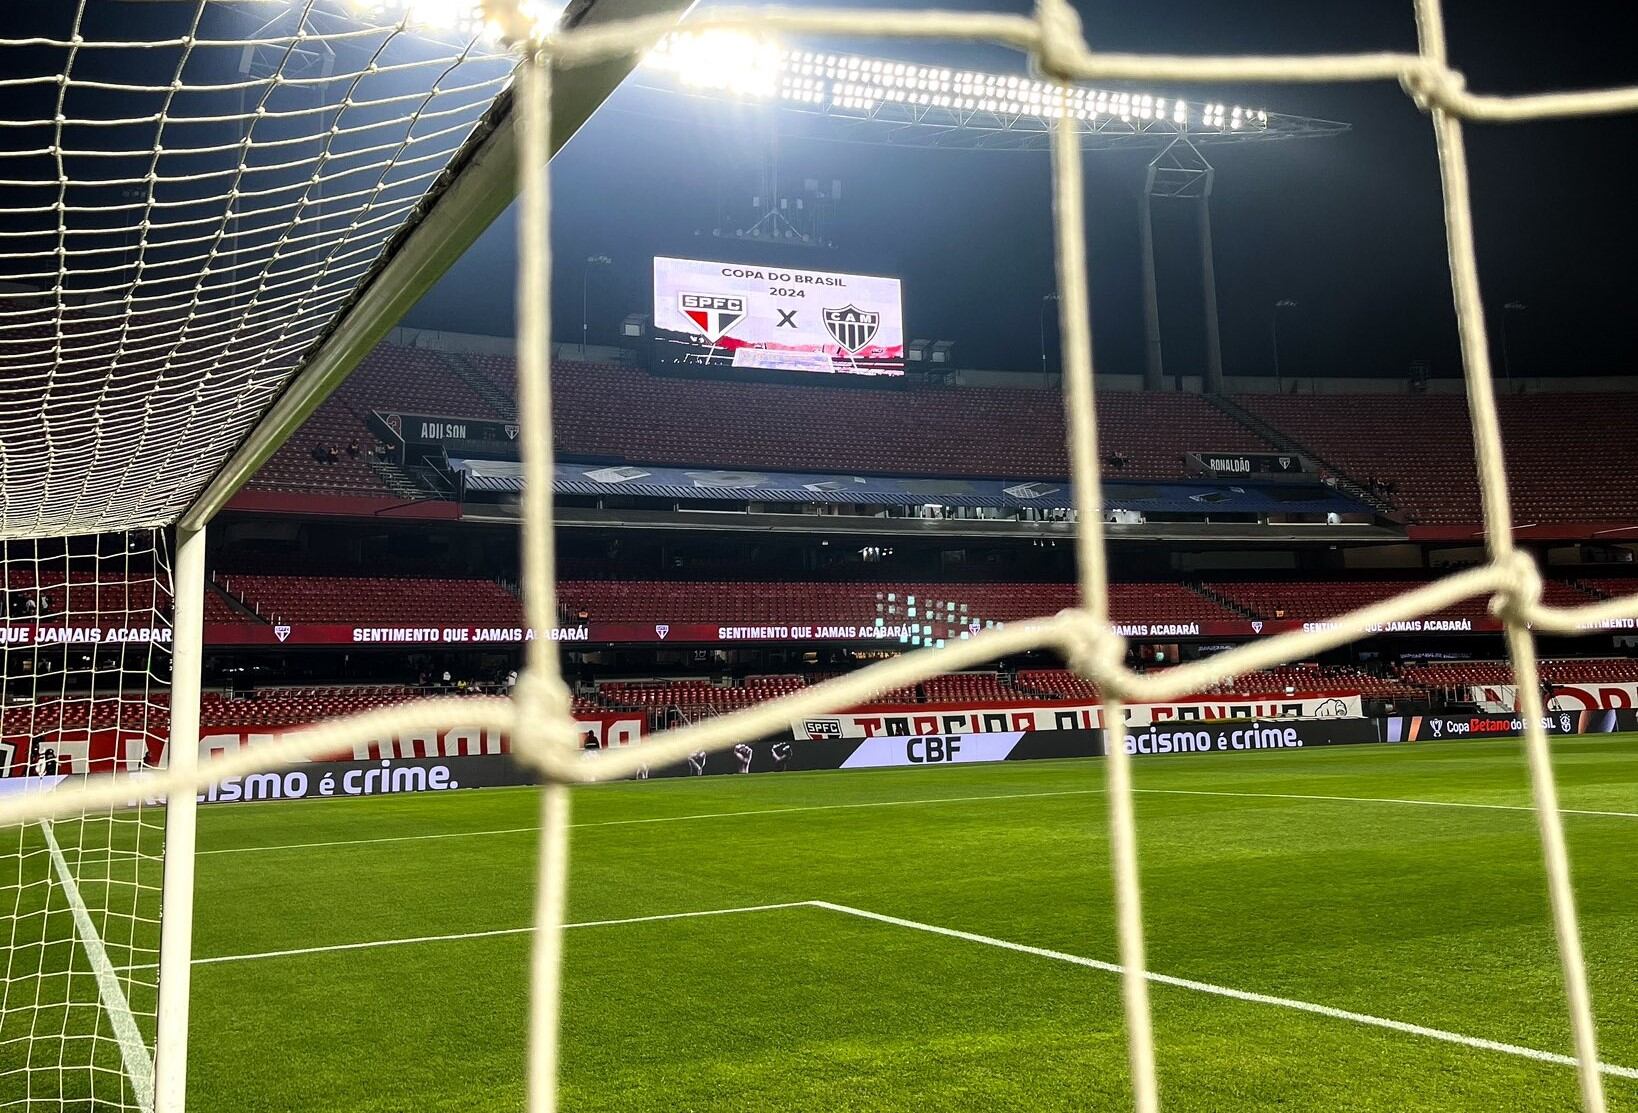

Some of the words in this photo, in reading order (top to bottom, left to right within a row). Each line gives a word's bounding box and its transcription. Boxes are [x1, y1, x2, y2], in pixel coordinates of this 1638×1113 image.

[721, 268, 764, 280] COPA
[768, 272, 791, 283] DO
[794, 274, 847, 287] BRASIL
[769, 287, 805, 298] 2024
[683, 295, 741, 311] SPFC
[776, 308, 799, 329] X
[830, 312, 872, 325] CAM
[1210, 457, 1250, 473] RONALDÃO
[718, 626, 788, 639] SENTIMENTO
[791, 626, 812, 639] QUE
[815, 626, 856, 638] JAMAIS
[858, 624, 912, 638] ACABARÁ!
[1150, 622, 1200, 635] ACABARÁ!
[1385, 620, 1421, 632] JAMAIS
[1423, 618, 1471, 631] ACABARÁ!
[35, 628, 101, 642] JAMAIS
[353, 628, 439, 642] SENTIMENTO
[443, 628, 468, 642] QUE
[472, 628, 522, 641] JAMAIS
[525, 625, 588, 641] AABARÁ!
[807, 721, 839, 734] SPFC
[1446, 720, 1470, 734] Copa
[1470, 718, 1510, 732] Betano
[1511, 718, 1522, 730] do
[1523, 717, 1556, 729] BSIL
[1217, 732, 1228, 750] é
[1231, 722, 1304, 750] crime.
[906, 736, 962, 763] CBF
[319, 772, 336, 796] é
[342, 759, 459, 795] crime.
